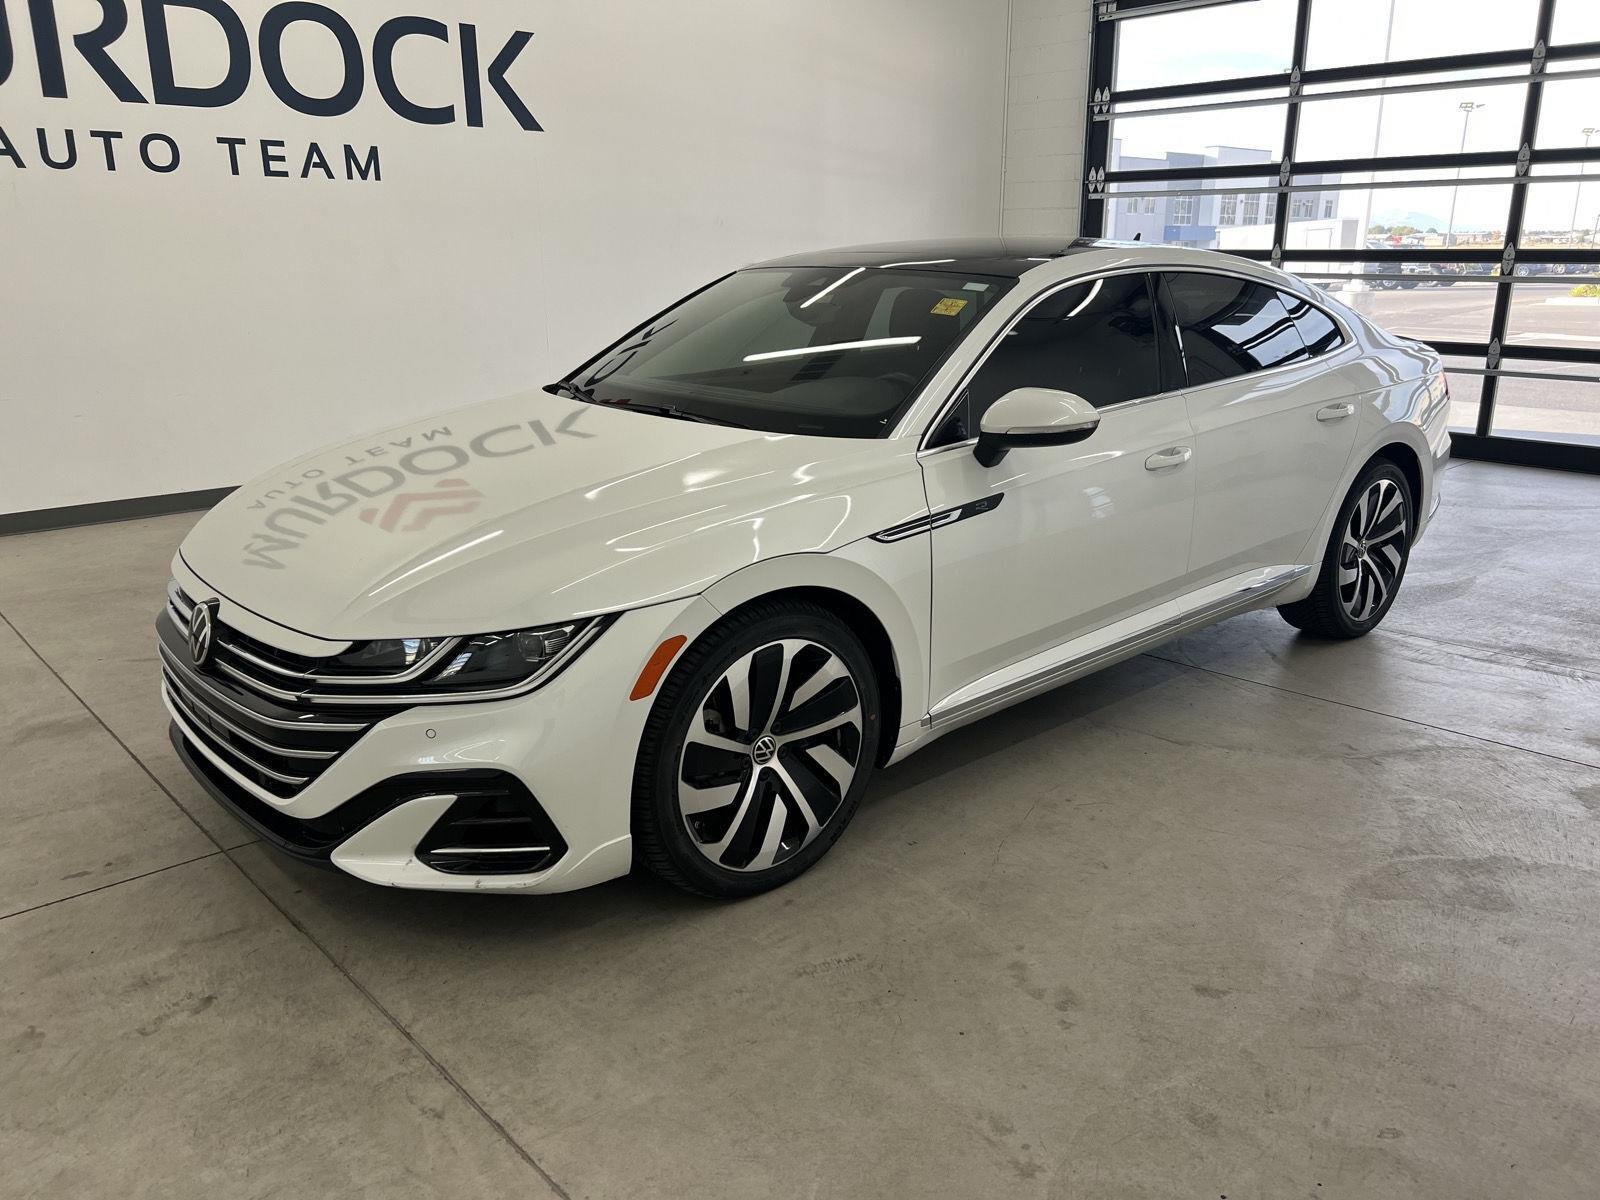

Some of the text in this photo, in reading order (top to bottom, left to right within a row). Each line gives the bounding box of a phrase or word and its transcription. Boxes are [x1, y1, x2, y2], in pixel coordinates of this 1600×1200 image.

[0, 0, 545, 133] RDOCK
[0, 127, 382, 181] AUTO TEAM
